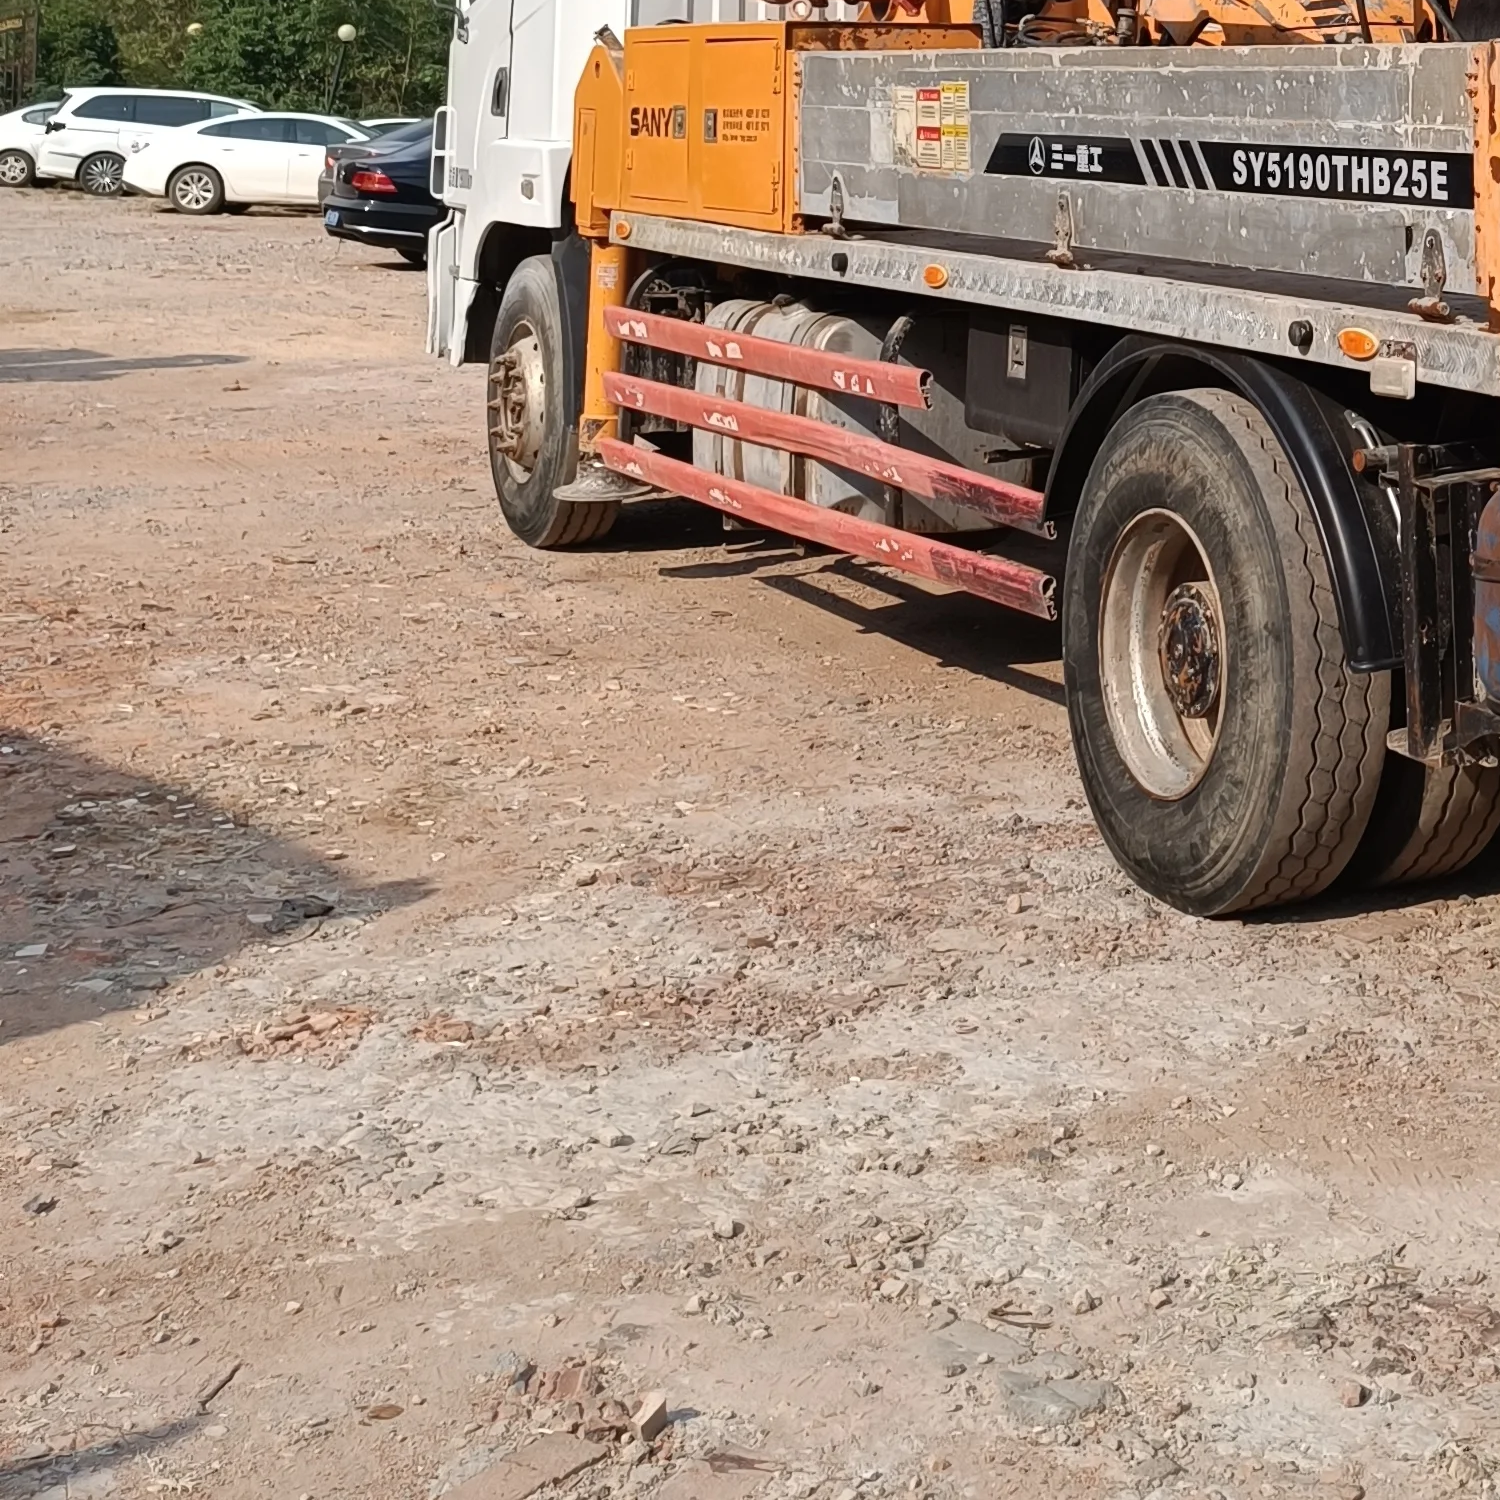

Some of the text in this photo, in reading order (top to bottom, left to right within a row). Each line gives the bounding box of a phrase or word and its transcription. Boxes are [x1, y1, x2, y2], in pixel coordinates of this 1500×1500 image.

[630, 106, 673, 137] SANY
[1050, 143, 1103, 172] 三一重工
[1232, 149, 1449, 201] SY5190THB25E
